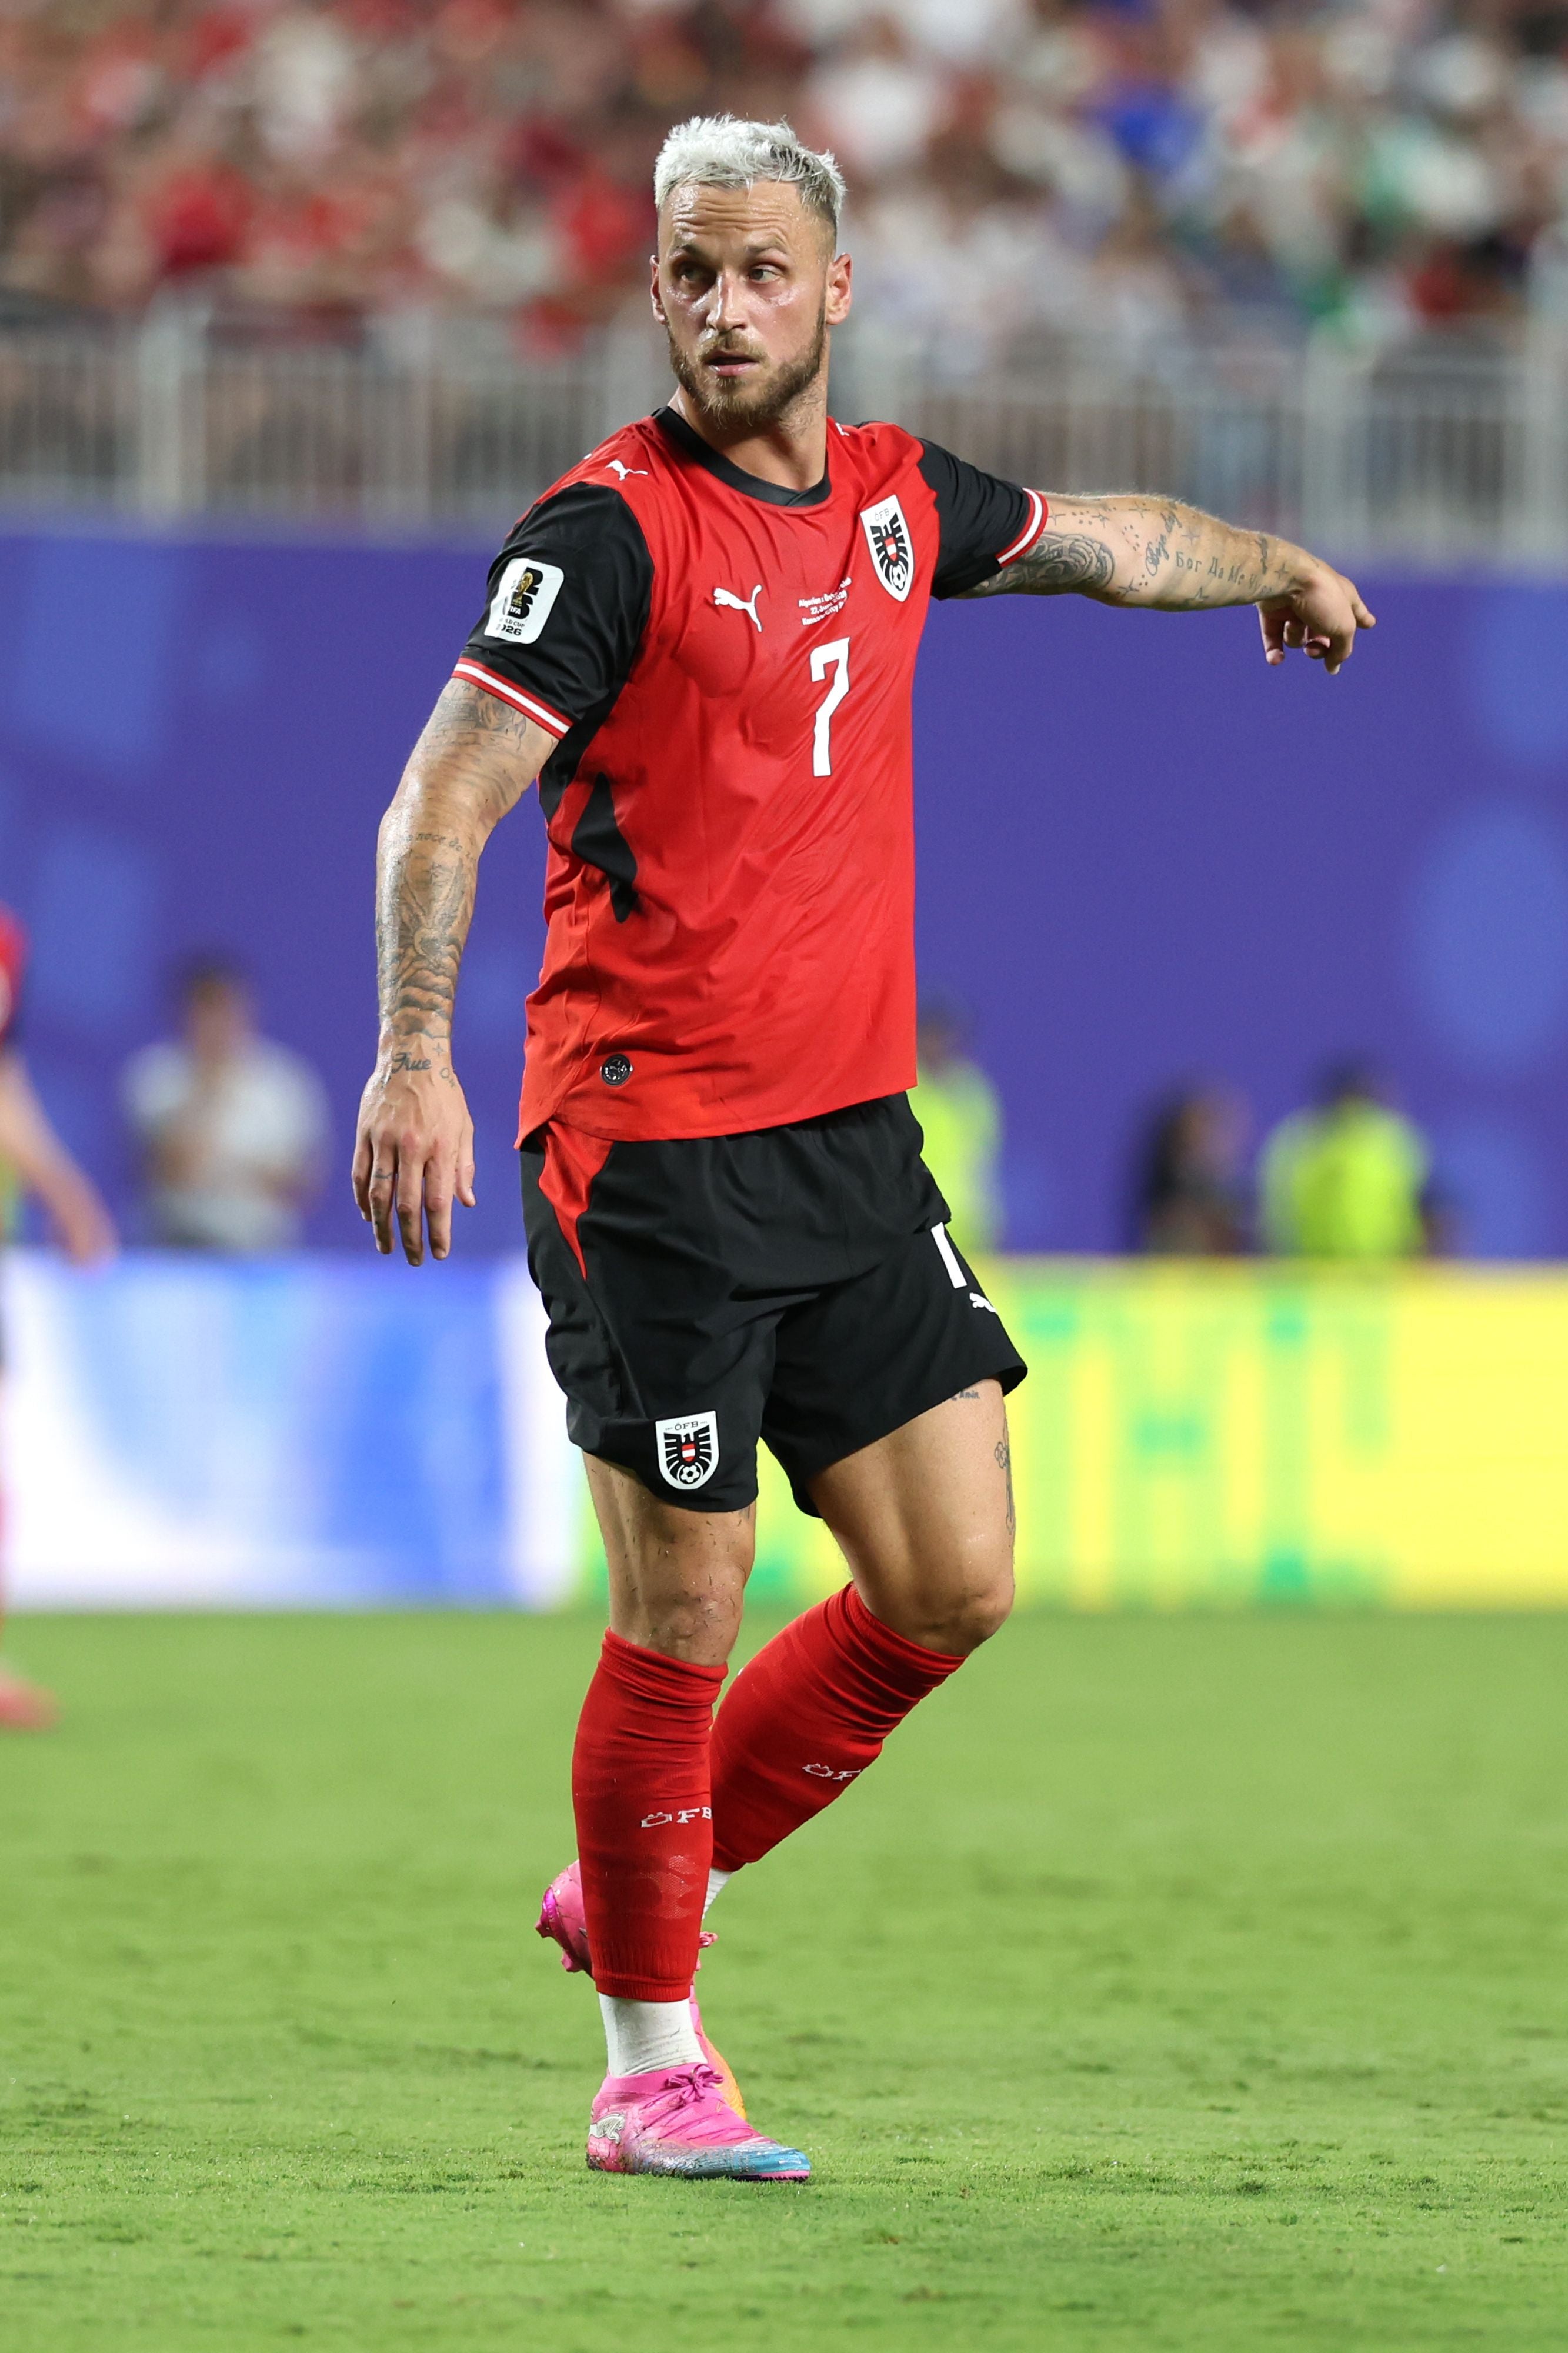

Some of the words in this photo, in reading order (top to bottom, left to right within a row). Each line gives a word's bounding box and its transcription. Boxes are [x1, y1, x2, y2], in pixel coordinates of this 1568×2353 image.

[810, 636, 850, 777] 7
[674, 1421, 699, 1431] ÖFB
[641, 1806, 712, 1828] ÖFB
